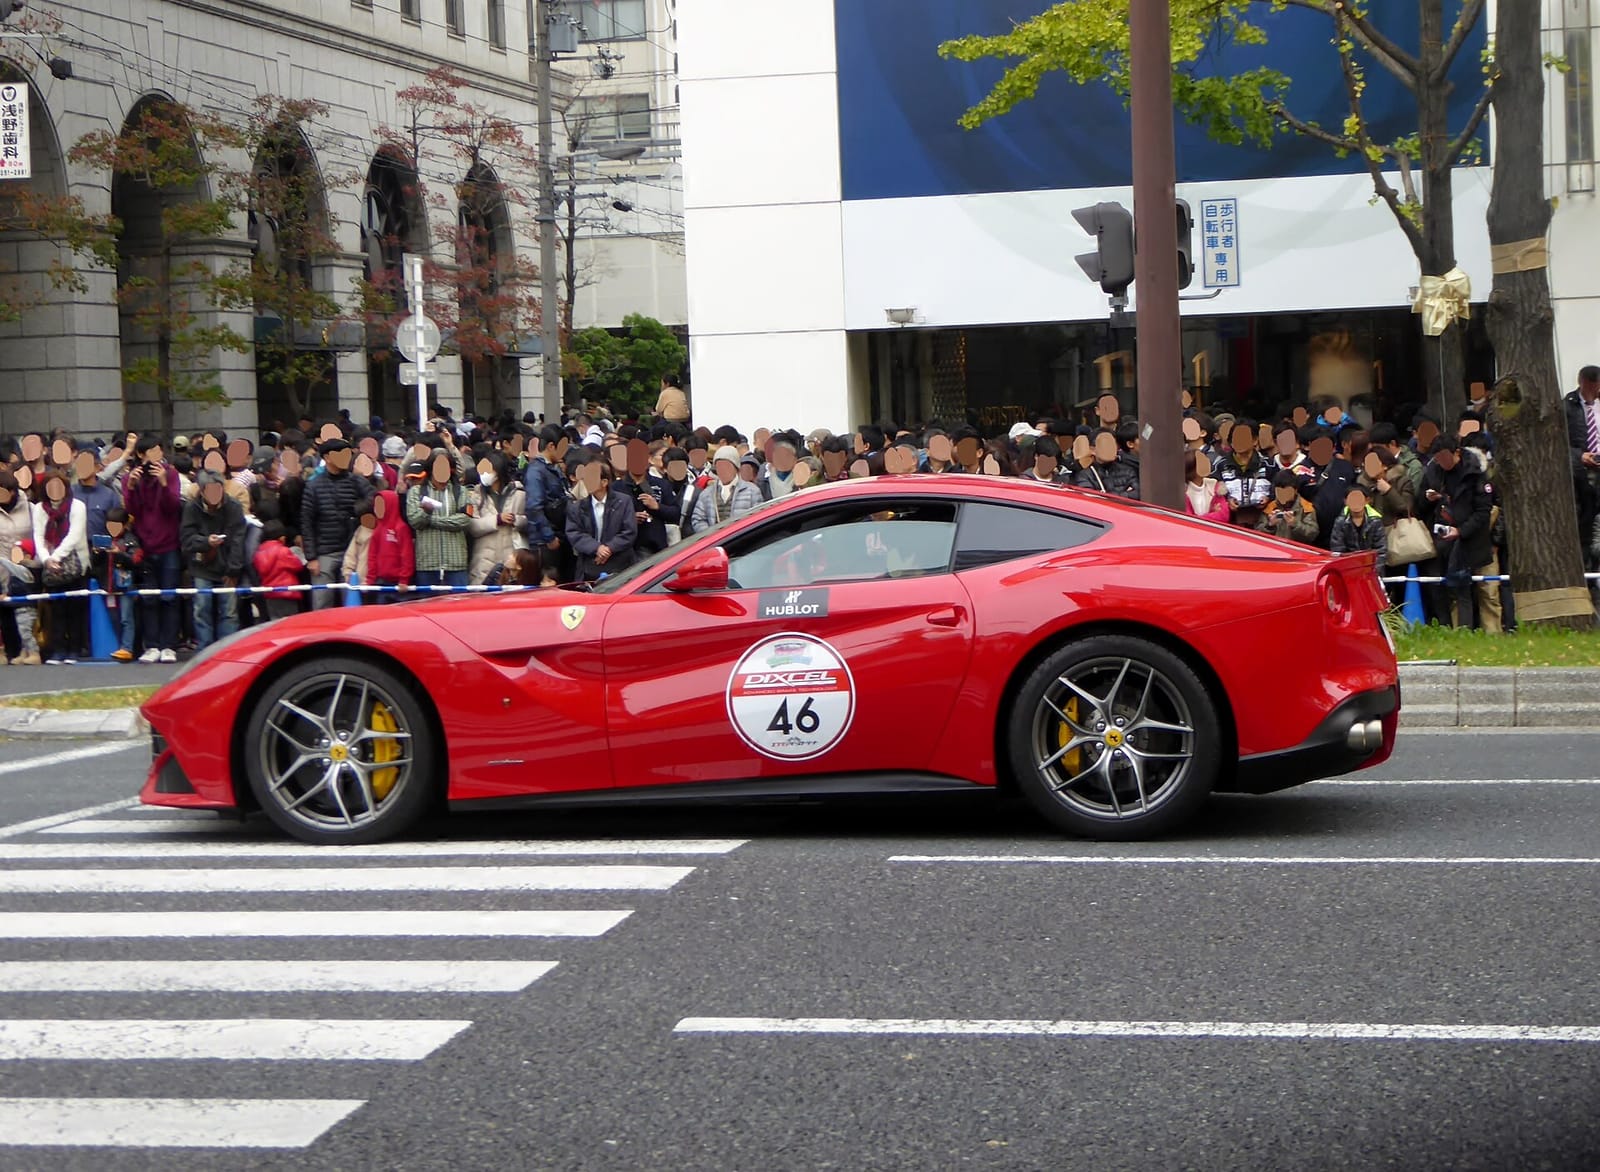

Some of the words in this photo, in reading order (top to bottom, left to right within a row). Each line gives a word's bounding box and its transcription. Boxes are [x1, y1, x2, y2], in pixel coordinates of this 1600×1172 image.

[2, 104, 19, 159] 浅野歯科
[1205, 204, 1219, 249] 自転車
[1220, 203, 1234, 248] 歩行者
[1214, 252, 1228, 282] 専用
[765, 604, 819, 616] HUBLOT
[744, 671, 837, 686] DIXCEL
[766, 696, 820, 735] 46
